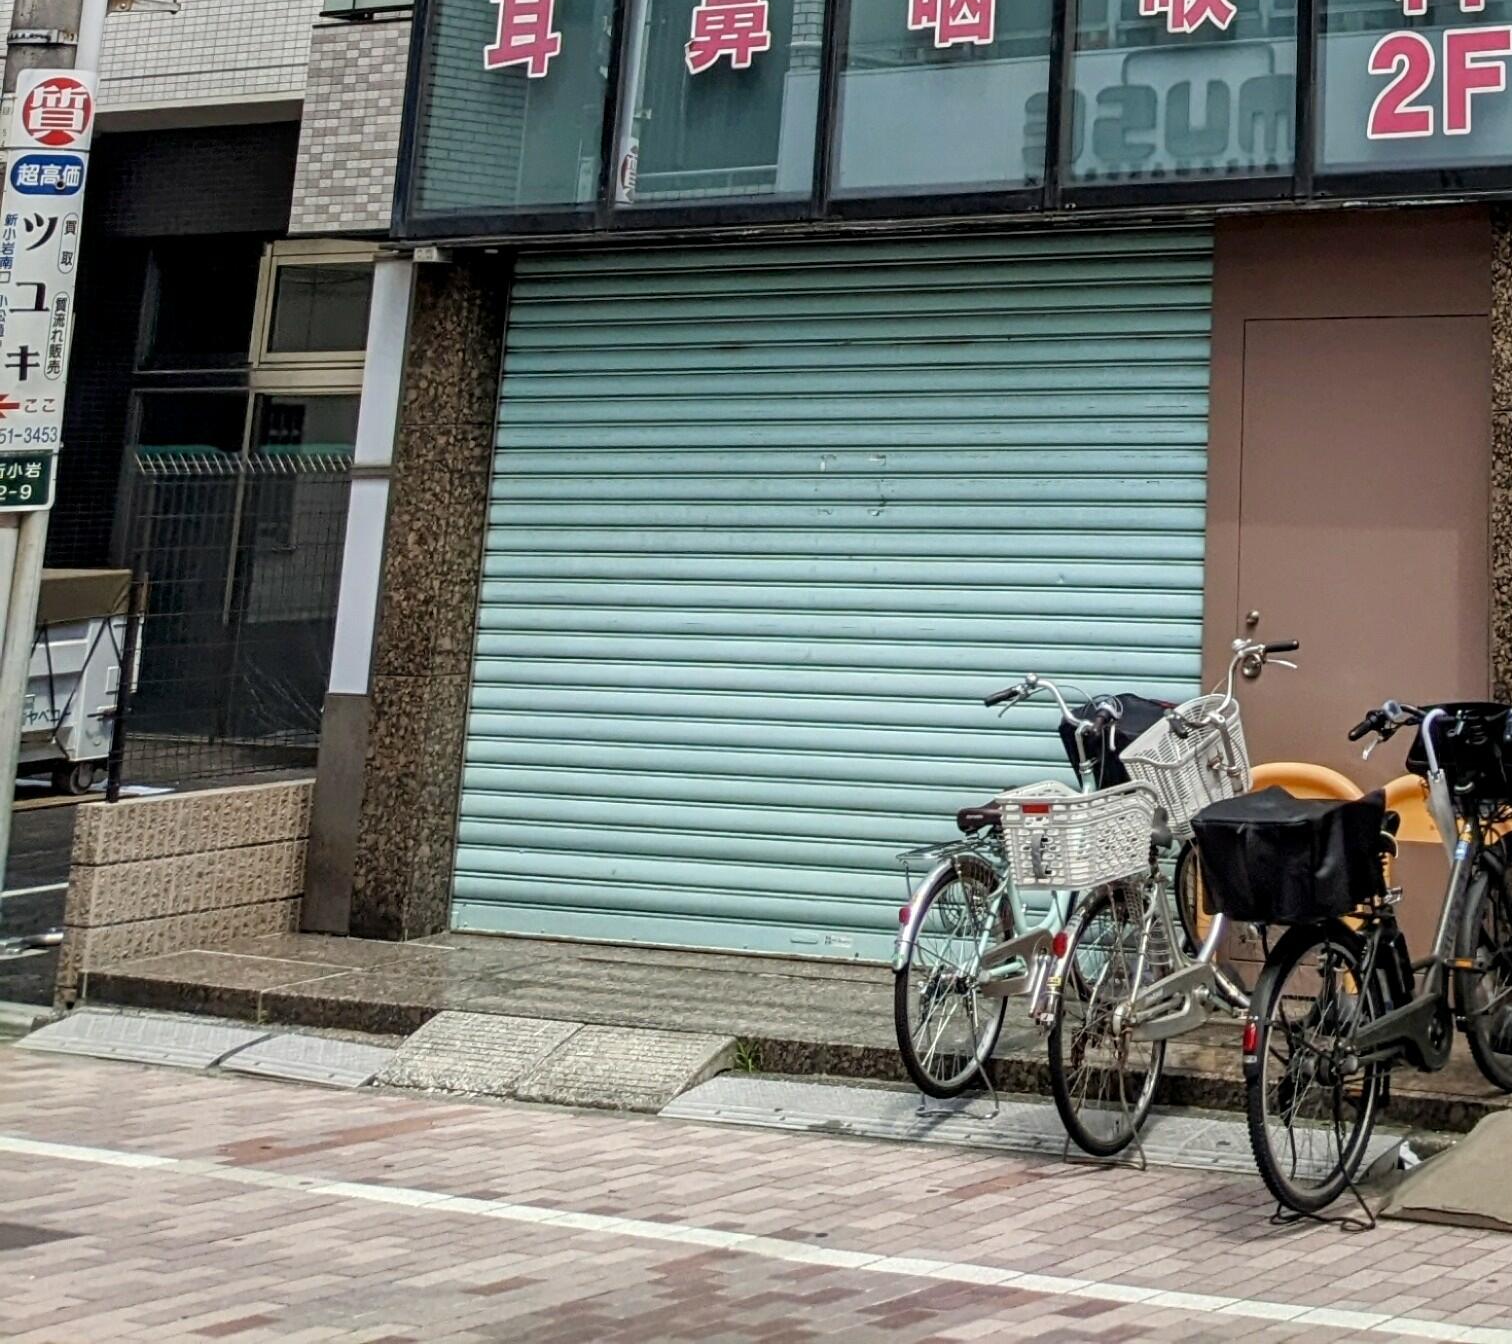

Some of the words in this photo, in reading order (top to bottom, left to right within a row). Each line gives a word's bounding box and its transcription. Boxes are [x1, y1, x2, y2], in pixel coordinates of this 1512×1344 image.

[28, 85, 88, 140] 質
[16, 163, 81, 187] 超高価
[60, 220, 77, 266] 買取
[5, 212, 58, 381] ツユキ
[25, 398, 56, 413] ここ
